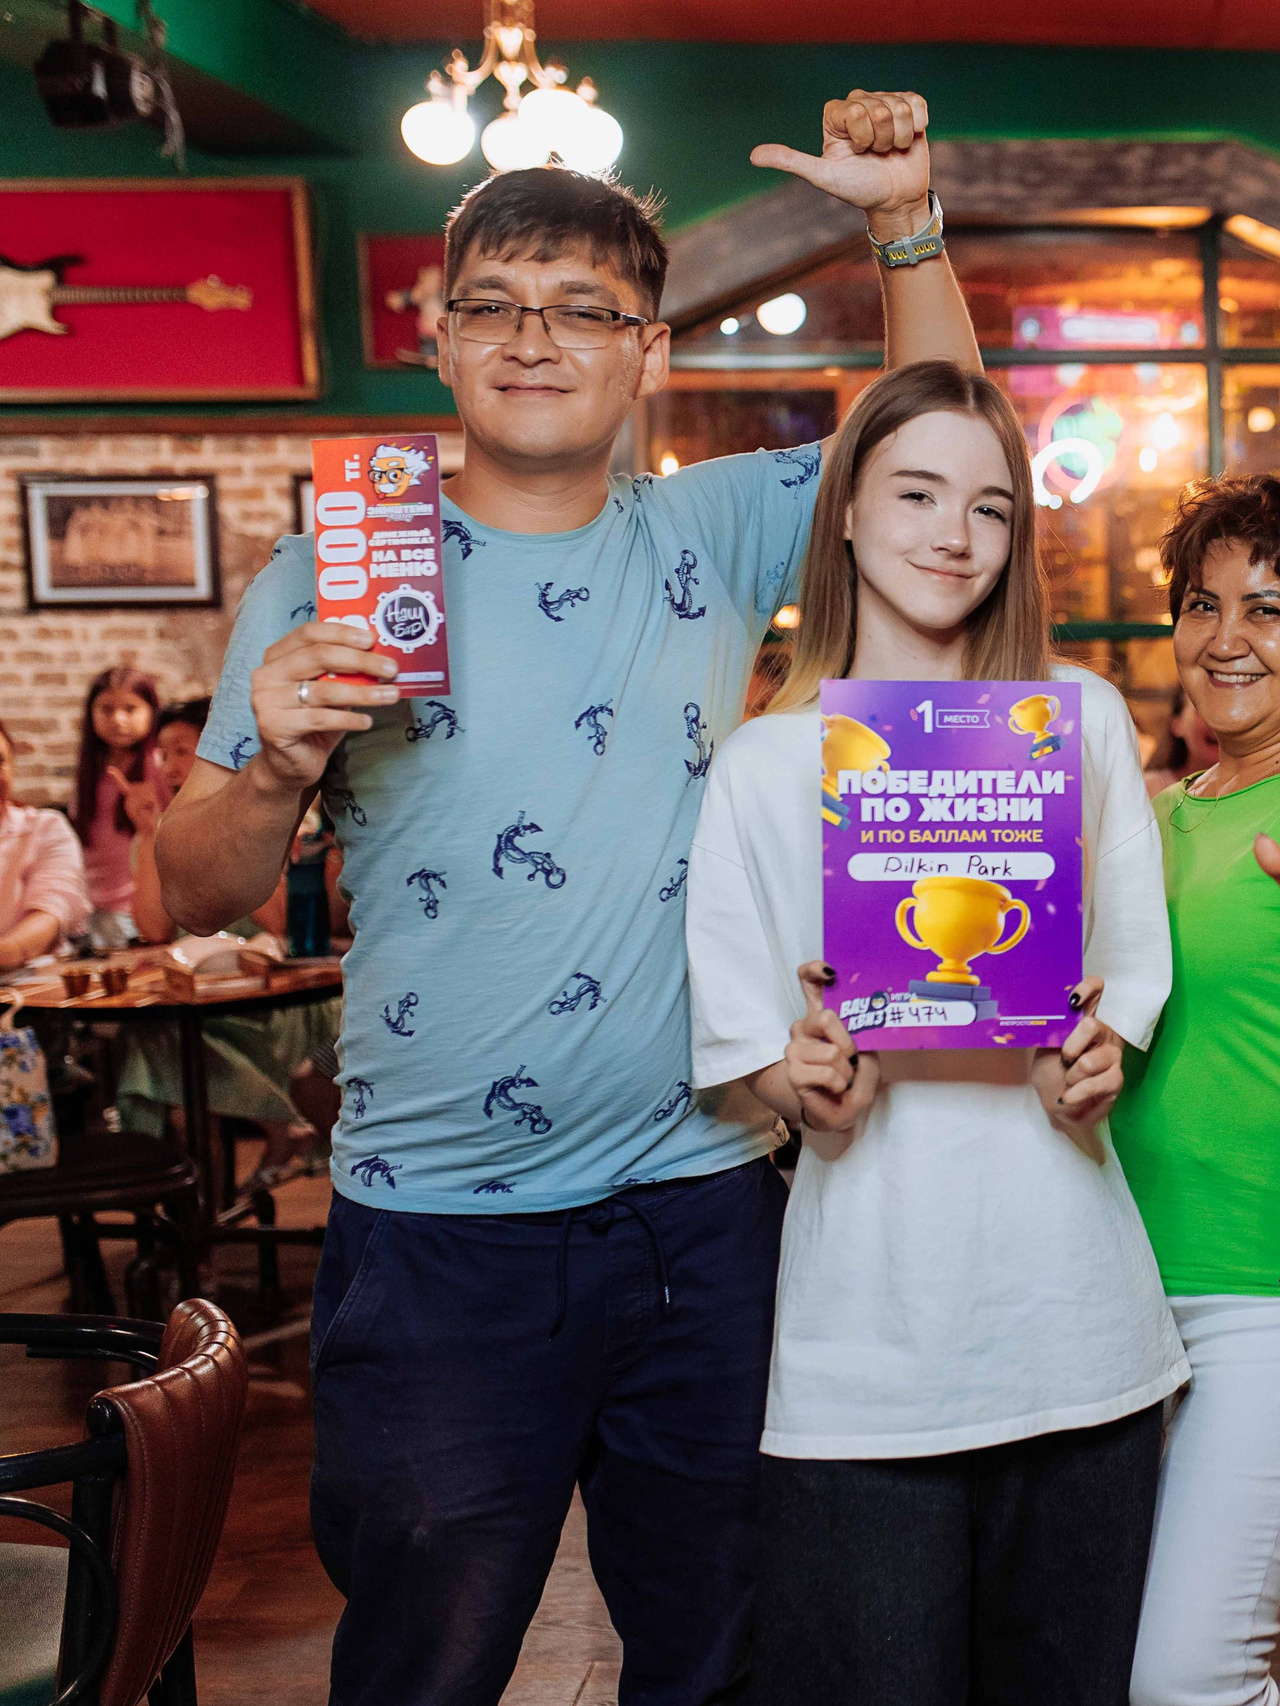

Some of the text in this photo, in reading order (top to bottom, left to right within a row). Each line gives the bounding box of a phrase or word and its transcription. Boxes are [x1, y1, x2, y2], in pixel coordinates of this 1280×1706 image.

[368, 536, 436, 547] СЕРТИФИКАТ
[371, 548, 436, 563] НА ВСЕ
[369, 560, 439, 579] МЕНЮ
[915, 700, 980, 734] 1 МЕСТО
[837, 770, 1065, 797] ПОБЕДИТЕЛИ
[860, 796, 1043, 822] ПО ЖИЗНИ
[861, 829, 1043, 844] И ПО БАЛЛАМ ТОЖЕ
[884, 855, 1013, 877] Dilkin Park
